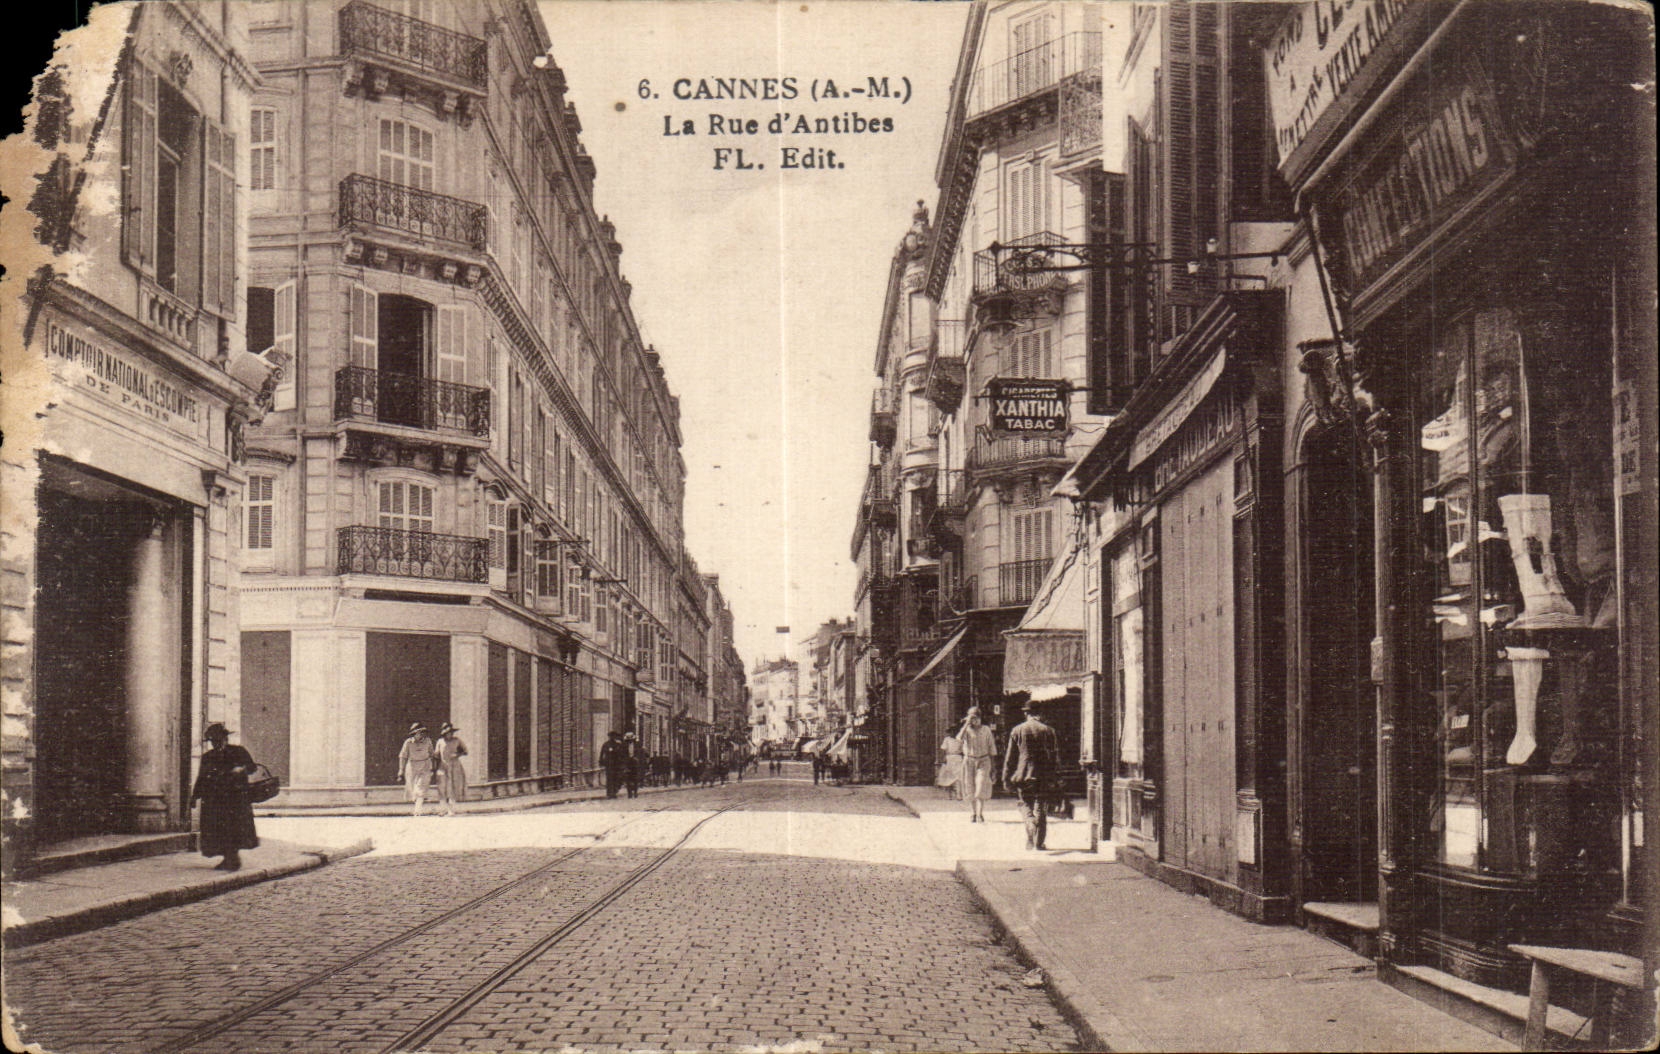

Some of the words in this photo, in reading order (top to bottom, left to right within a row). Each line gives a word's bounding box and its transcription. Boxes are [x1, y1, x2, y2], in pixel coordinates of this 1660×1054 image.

[1325, 23, 1367, 102] VENTE
[50, 325, 104, 377] COMPTOIR
[105, 353, 149, 400] NATIONAL
[86, 374, 110, 394] DE
[121, 392, 170, 422] PARIS
[995, 399, 1065, 417] XANTHIA
[1005, 418, 1056, 429] TABAC
